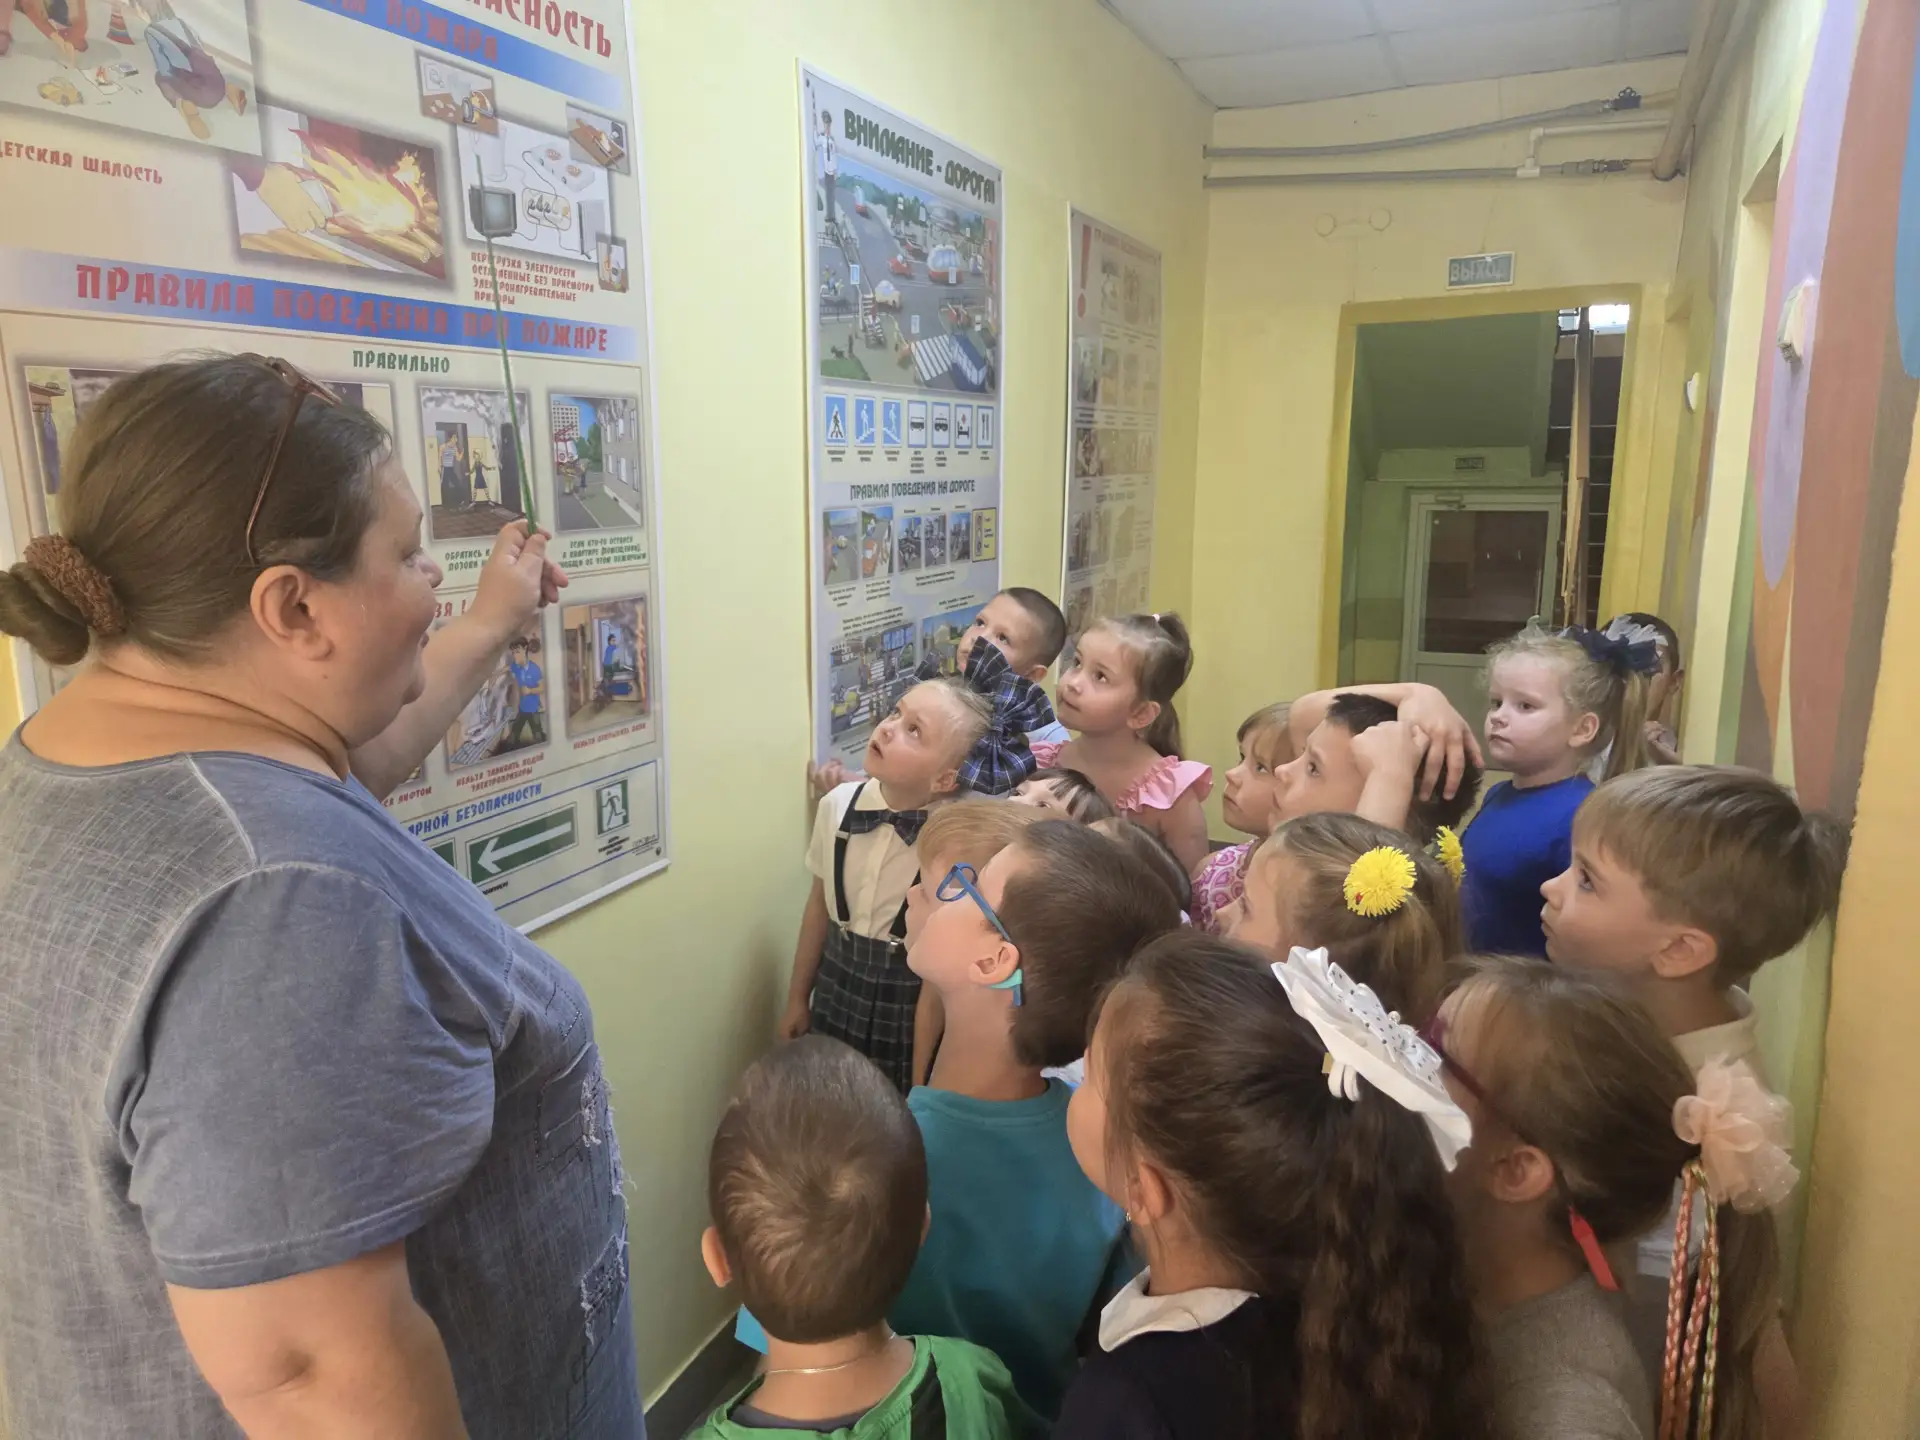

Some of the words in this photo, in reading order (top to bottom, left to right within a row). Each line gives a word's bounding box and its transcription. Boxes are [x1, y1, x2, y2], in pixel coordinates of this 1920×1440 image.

[387, 0, 497, 62] ПОЖАРА
[464, 0, 611, 57] СНОСТЬ
[844, 108, 933, 177] ВНИМАНИЕ
[0, 140, 73, 168] ЕТСКАЯ
[82, 155, 163, 185] ШАЛОСТЬ
[471, 252, 521, 269] ПЕРРУЗКА
[525, 260, 576, 279] ЭЛЕКТРОСЕТИ
[472, 264, 530, 283] ОСТЛЕННЫЕ
[534, 275, 548, 286] БЕЗ
[551, 279, 594, 293] ПРИСМОТРА
[473, 277, 577, 302] ЭЛЕКРОНАГРЕВАТЕЛЬНЫЕ
[474, 291, 515, 305] ПРИРЫ
[77, 264, 255, 314] ПРАВИЛА
[273, 288, 448, 335] ПОВЕДЕНИЯ
[463, 311, 509, 341] ПРИ
[522, 319, 608, 352] ПОЖАРЕ
[352, 350, 450, 373] ПРАВИЛЬНО
[850, 483, 889, 501] ПРАВИЛА
[892, 481, 936, 499] ПОВЕДЕНИЯ
[938, 480, 948, 495] НА
[950, 479, 975, 493] ДОРОГЕ
[445, 547, 482, 561] ОБРАТИСЬ
[398, 786, 432, 804] ЛИФТОМ
[407, 810, 449, 837] АРНОЙ
[456, 783, 542, 823] БЕЗОПАСНОСТИ
